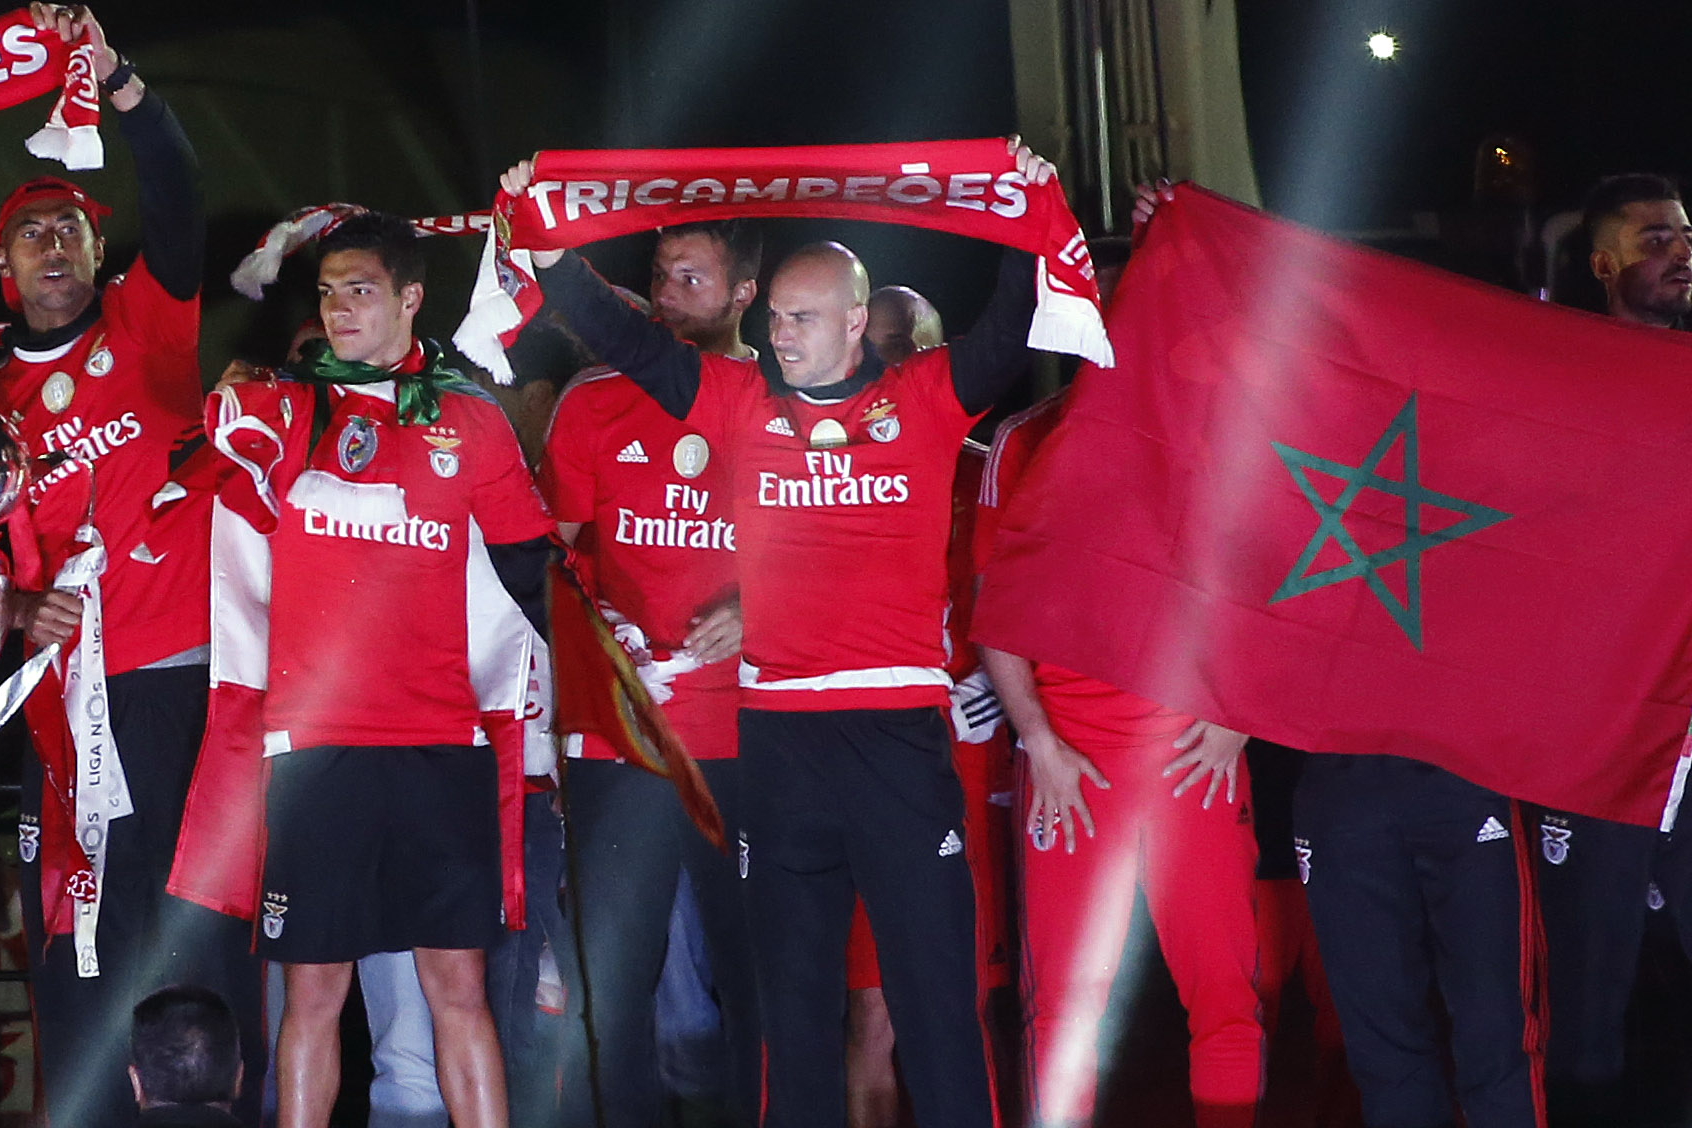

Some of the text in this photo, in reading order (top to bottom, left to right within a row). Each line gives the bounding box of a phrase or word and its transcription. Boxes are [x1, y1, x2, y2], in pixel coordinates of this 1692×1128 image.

[42, 416, 84, 453] Fly
[805, 451, 852, 478] Fly
[665, 483, 709, 516] Fly
[759, 472, 909, 507] Emirates
[615, 507, 737, 552] Emirate
[85, 682, 106, 786] LIGA NOS
